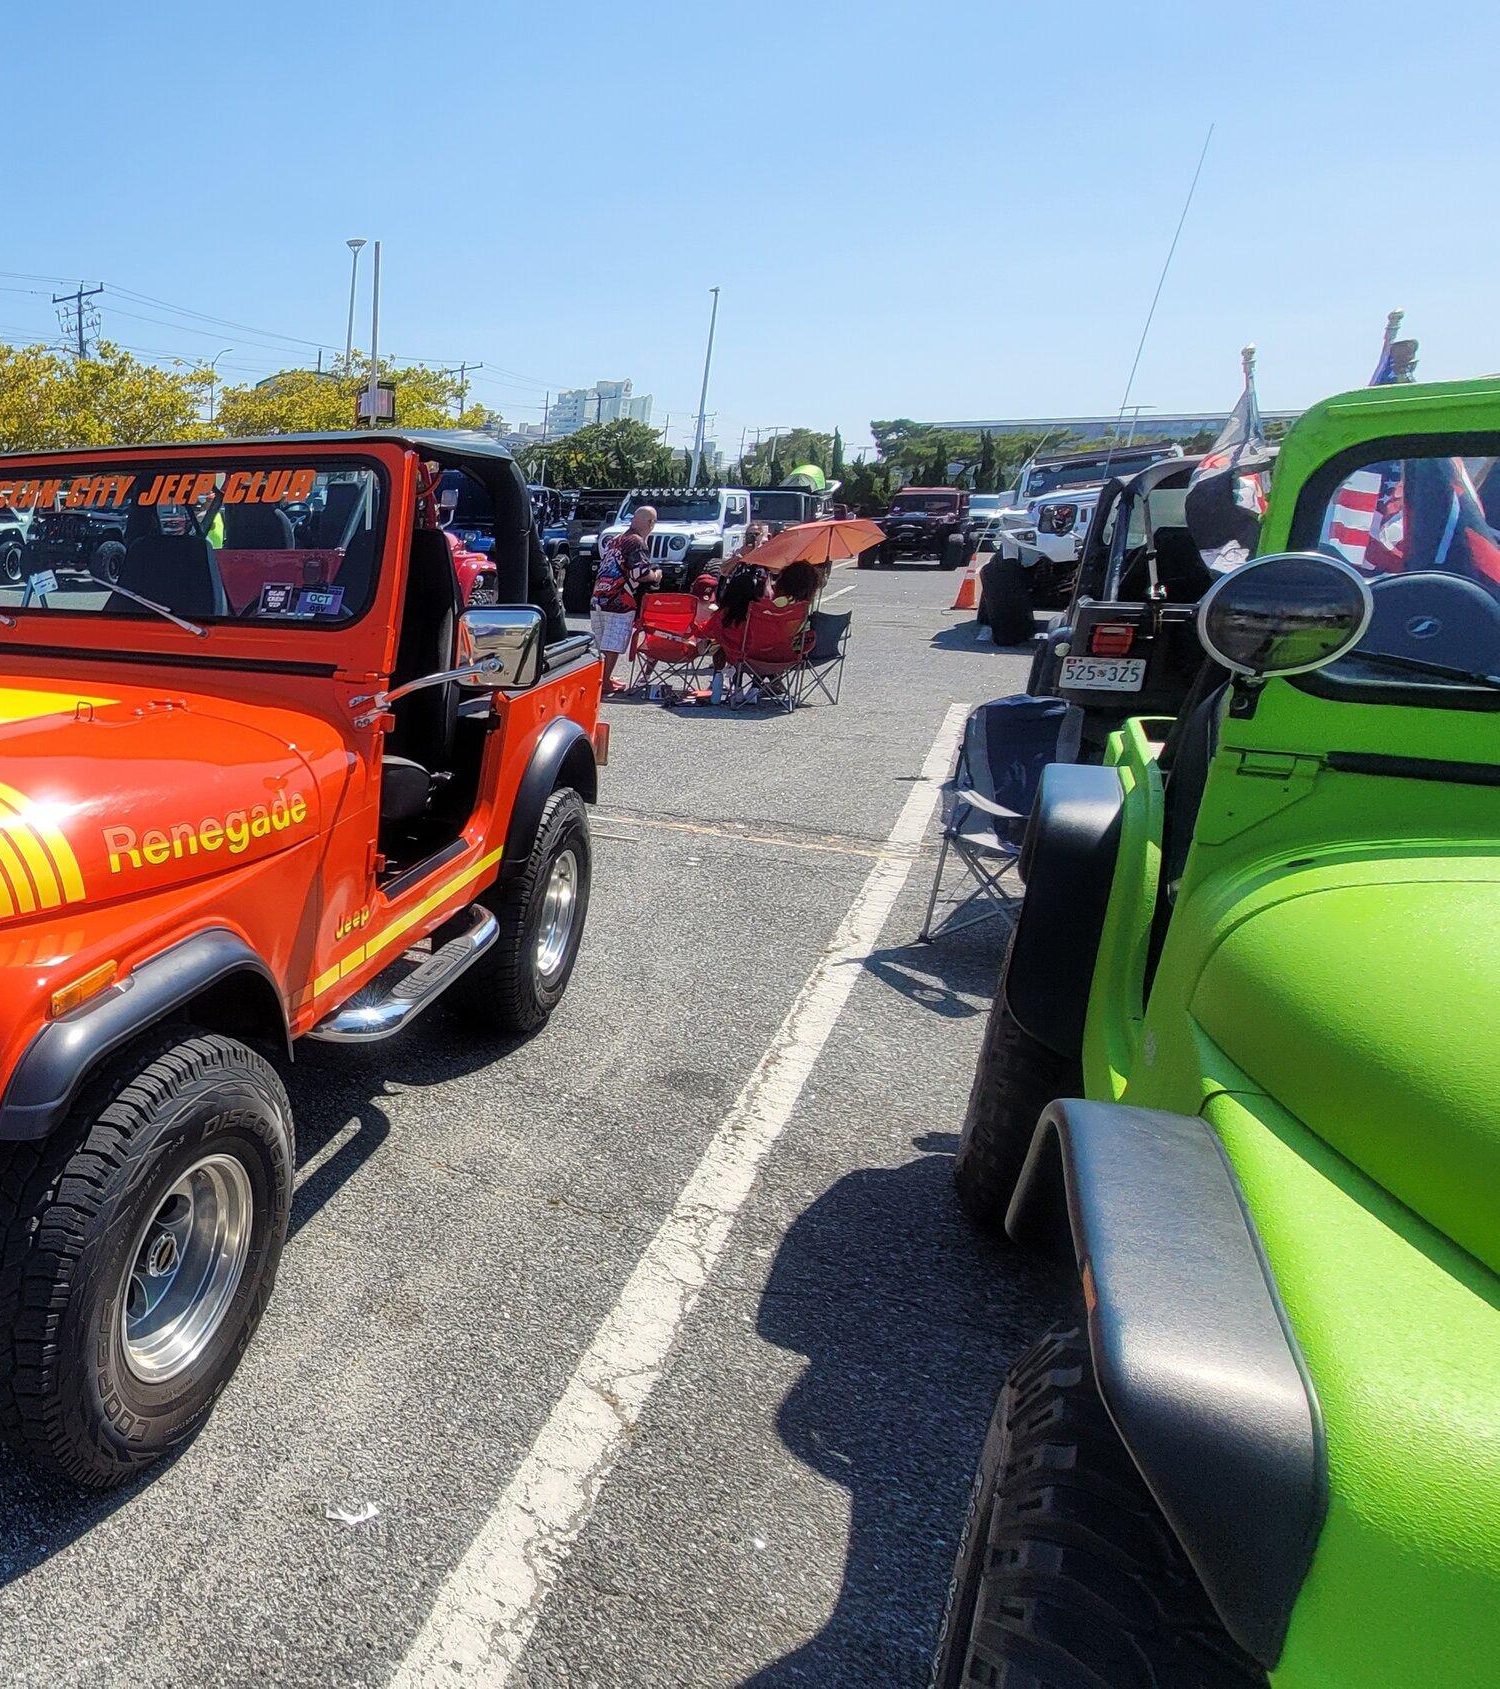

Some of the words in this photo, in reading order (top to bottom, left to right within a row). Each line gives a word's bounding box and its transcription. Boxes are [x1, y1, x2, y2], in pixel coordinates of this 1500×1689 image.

[65, 475, 137, 508] CITY
[137, 472, 217, 506] JEEP
[222, 469, 317, 504] CLUB
[309, 593, 332, 605] OCT
[1065, 665, 1097, 681] 525
[101, 787, 307, 874] Renegade
[334, 903, 370, 941] Jeep
[97, 1299, 151, 1441] COOPER
